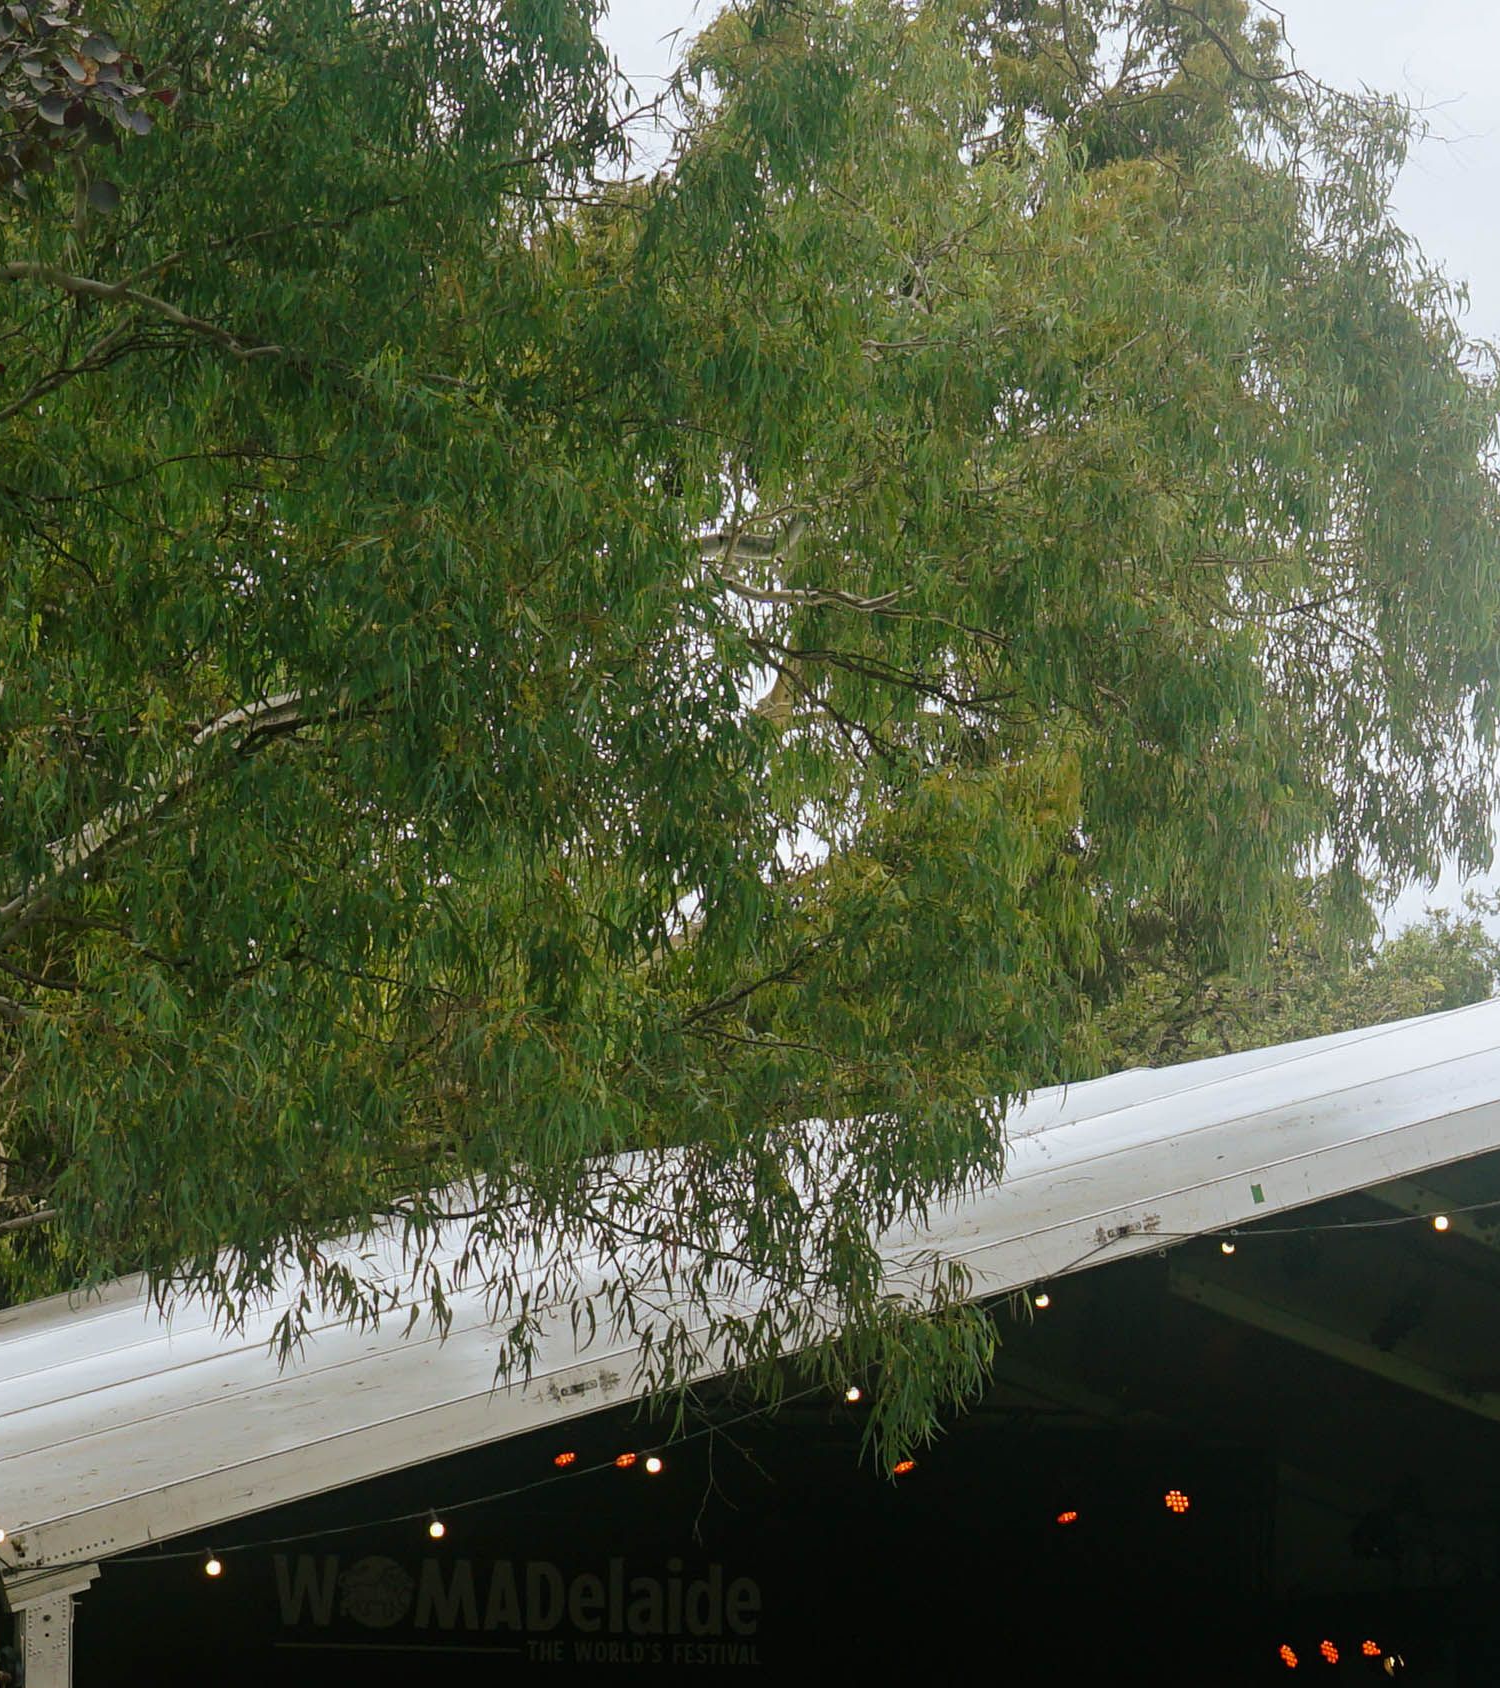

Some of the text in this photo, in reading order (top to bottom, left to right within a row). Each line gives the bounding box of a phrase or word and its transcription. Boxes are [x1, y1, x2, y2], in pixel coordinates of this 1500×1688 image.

[527, 1640, 761, 1665] THE WORLD'S FESTIVAL
